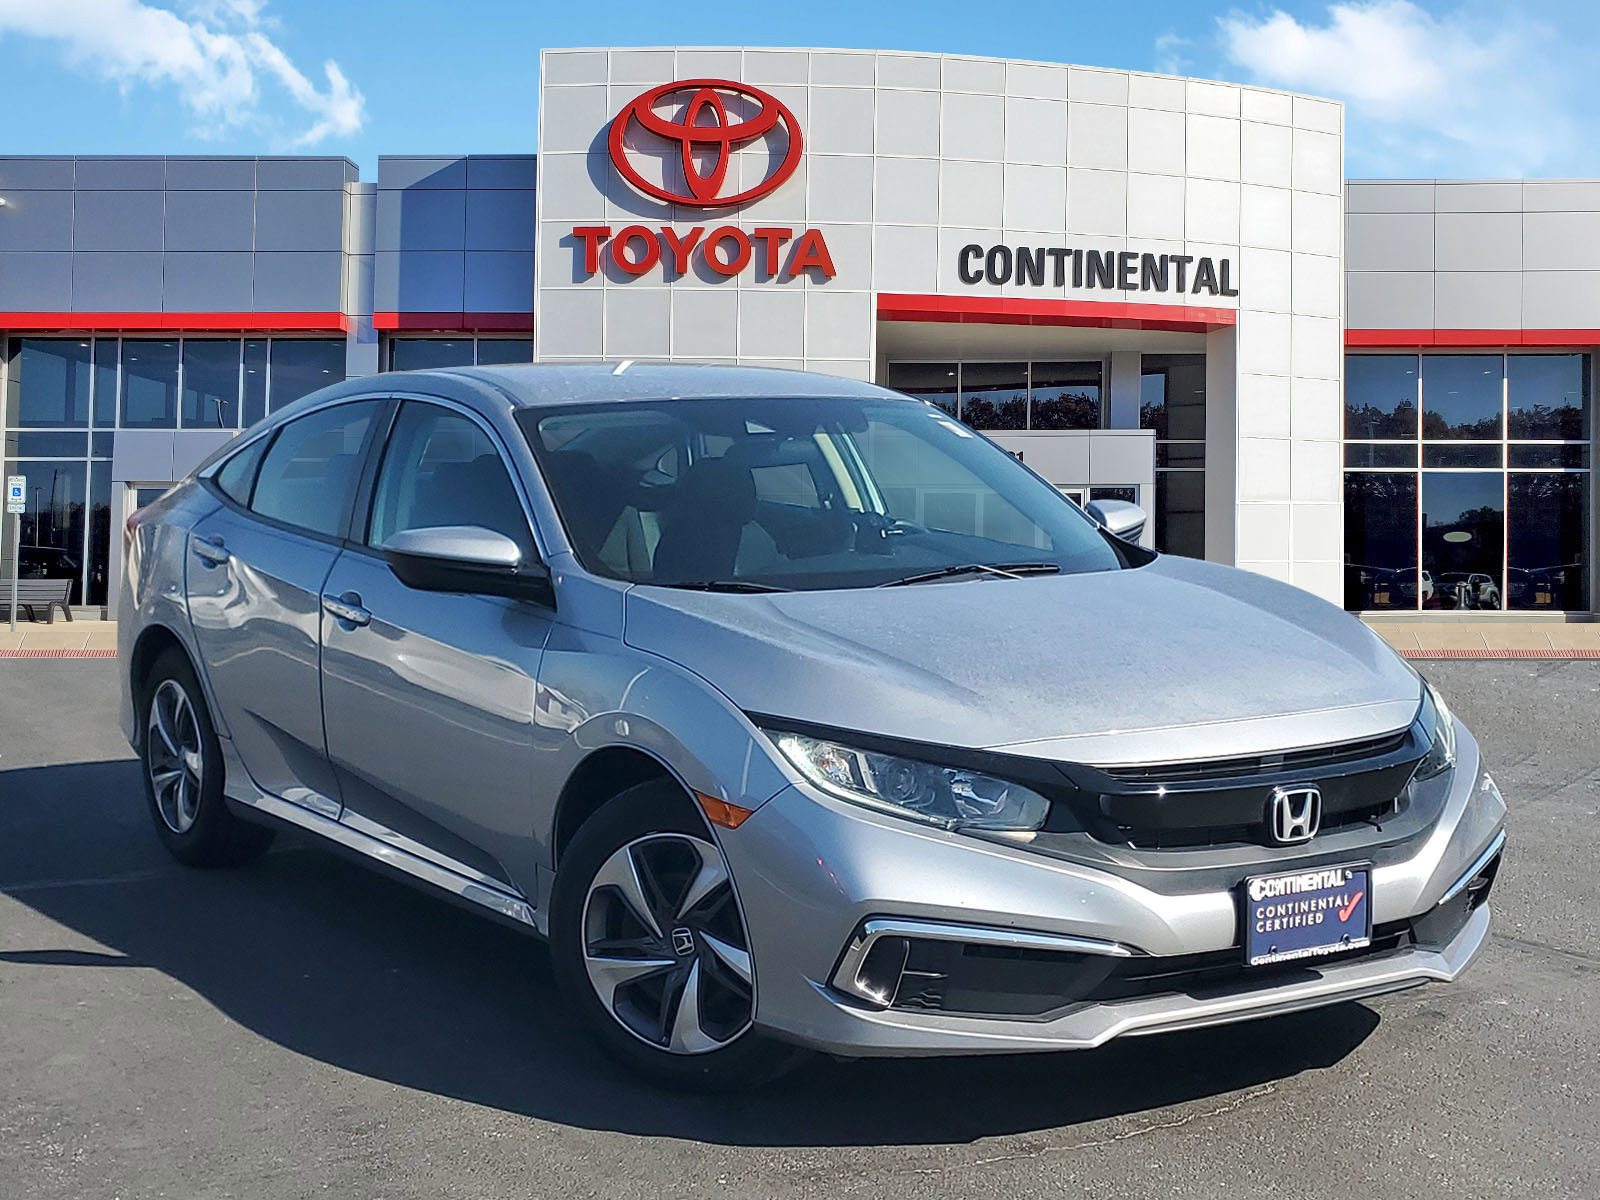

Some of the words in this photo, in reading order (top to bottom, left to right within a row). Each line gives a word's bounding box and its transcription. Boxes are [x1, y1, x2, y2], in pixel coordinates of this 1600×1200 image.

[572, 225, 836, 278] TOYOTA
[959, 243, 1239, 298] CONTINENTAL
[1249, 869, 1345, 901] CONTINENTAL
[1256, 894, 1350, 919] CONTINENTAL
[1256, 913, 1324, 933] CERTIFIED
